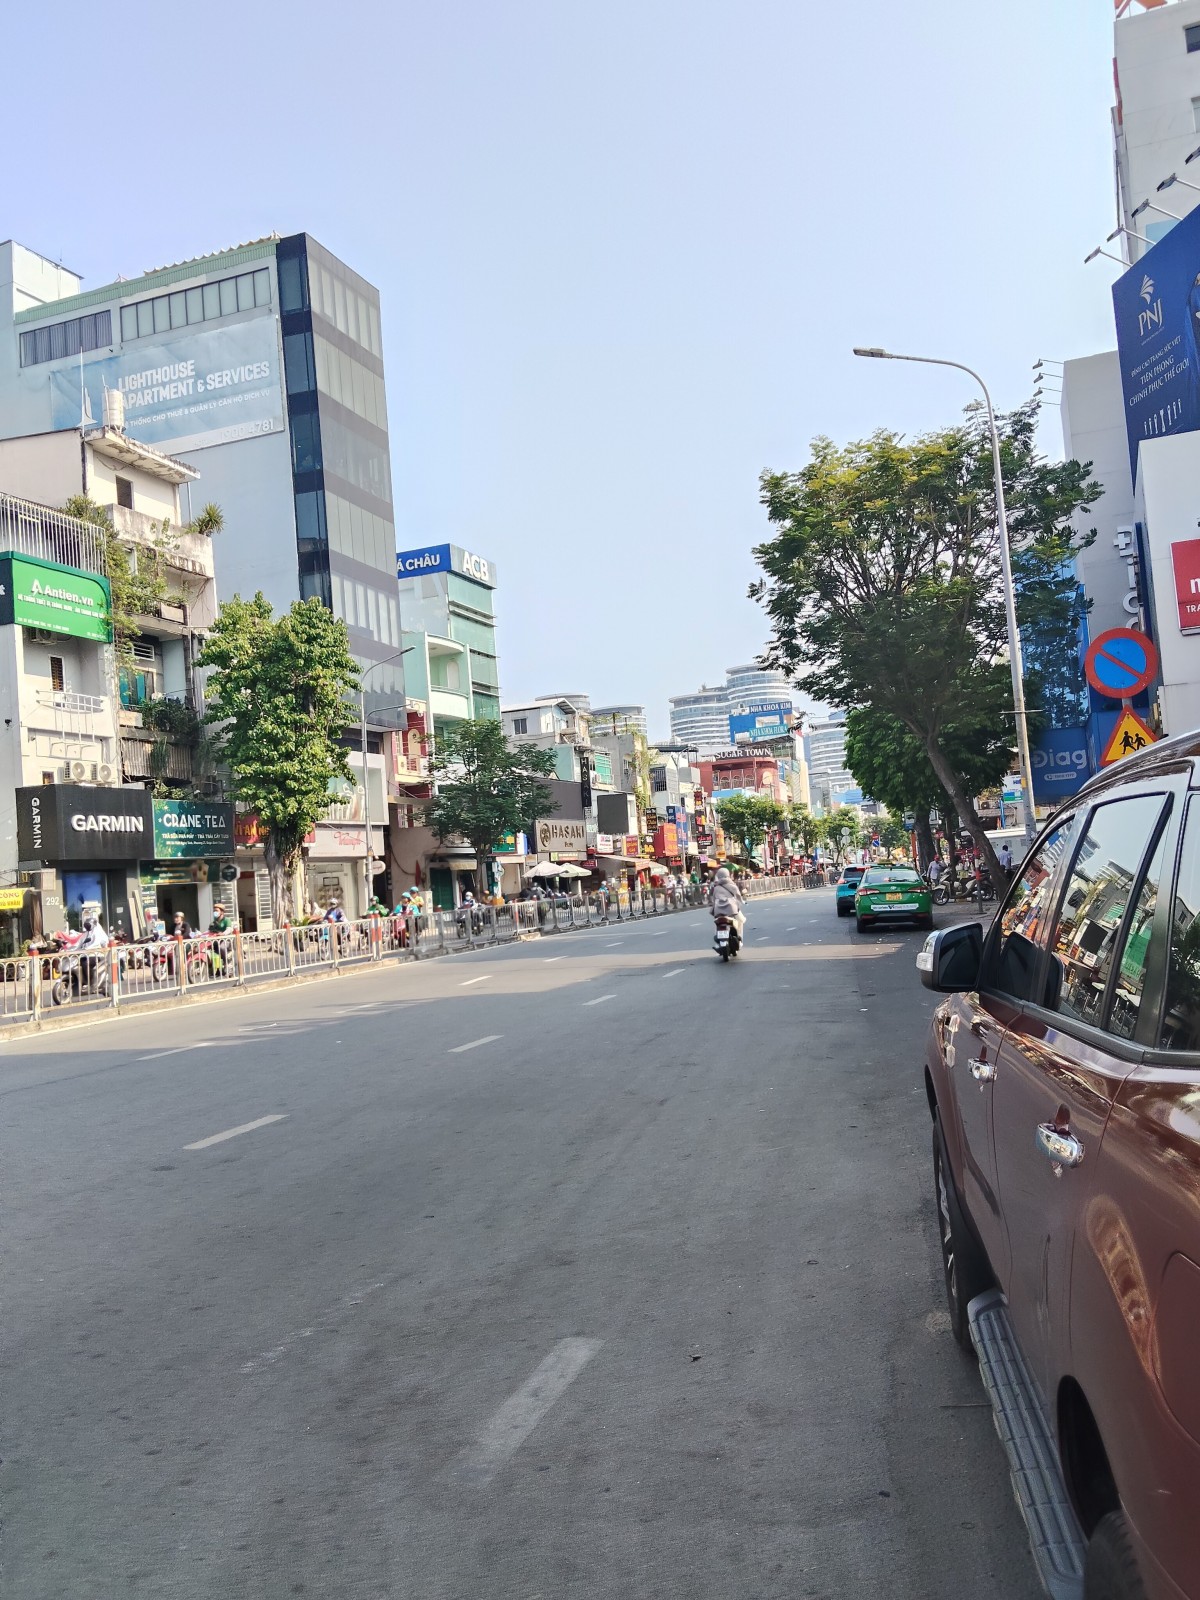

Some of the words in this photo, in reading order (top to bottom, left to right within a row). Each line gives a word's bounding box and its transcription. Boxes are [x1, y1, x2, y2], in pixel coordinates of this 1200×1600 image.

[1138, 299, 1163, 337] PNJ
[1153, 354, 1175, 377] PHONG
[118, 359, 195, 393] LIGHTHOUSE
[197, 379, 204, 393] &
[206, 360, 270, 390] SERVICES
[152, 412, 166, 423] CHO
[405, 553, 440, 571] CHÂU
[462, 551, 489, 581] ACB
[44, 585, 94, 606] Antien.vn
[763, 703, 779, 712] KHOA
[715, 750, 743, 758] SUGAR
[745, 748, 771, 756] TOWN
[31, 797, 42, 849] GARMIN
[71, 814, 144, 832] GARMIN
[163, 814, 202, 828] CRANE
[204, 815, 226, 828] TEA
[551, 825, 585, 839] HASAKI
[46, 897, 59, 906] 292
